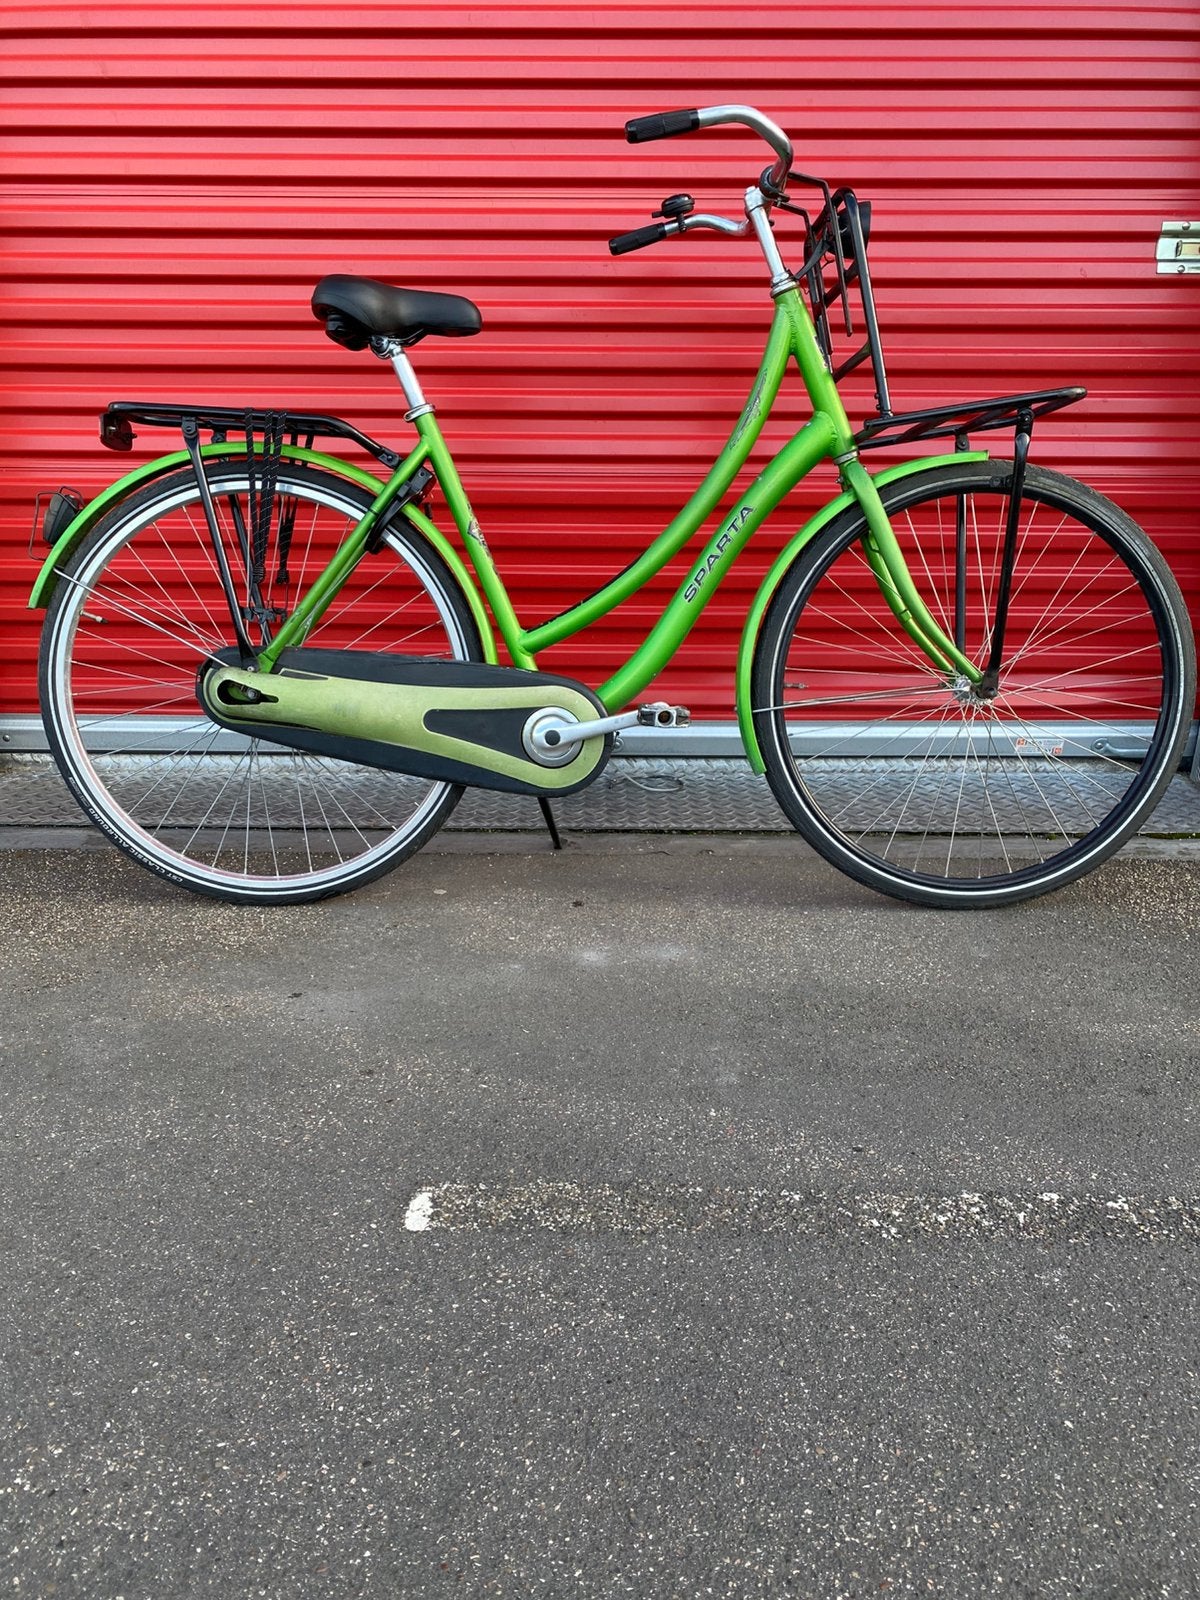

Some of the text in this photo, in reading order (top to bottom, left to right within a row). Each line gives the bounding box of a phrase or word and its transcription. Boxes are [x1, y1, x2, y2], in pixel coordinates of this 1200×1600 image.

[684, 505, 755, 602] SPARTA
[88, 808, 183, 883] CST CLASSIC ALLROUND
